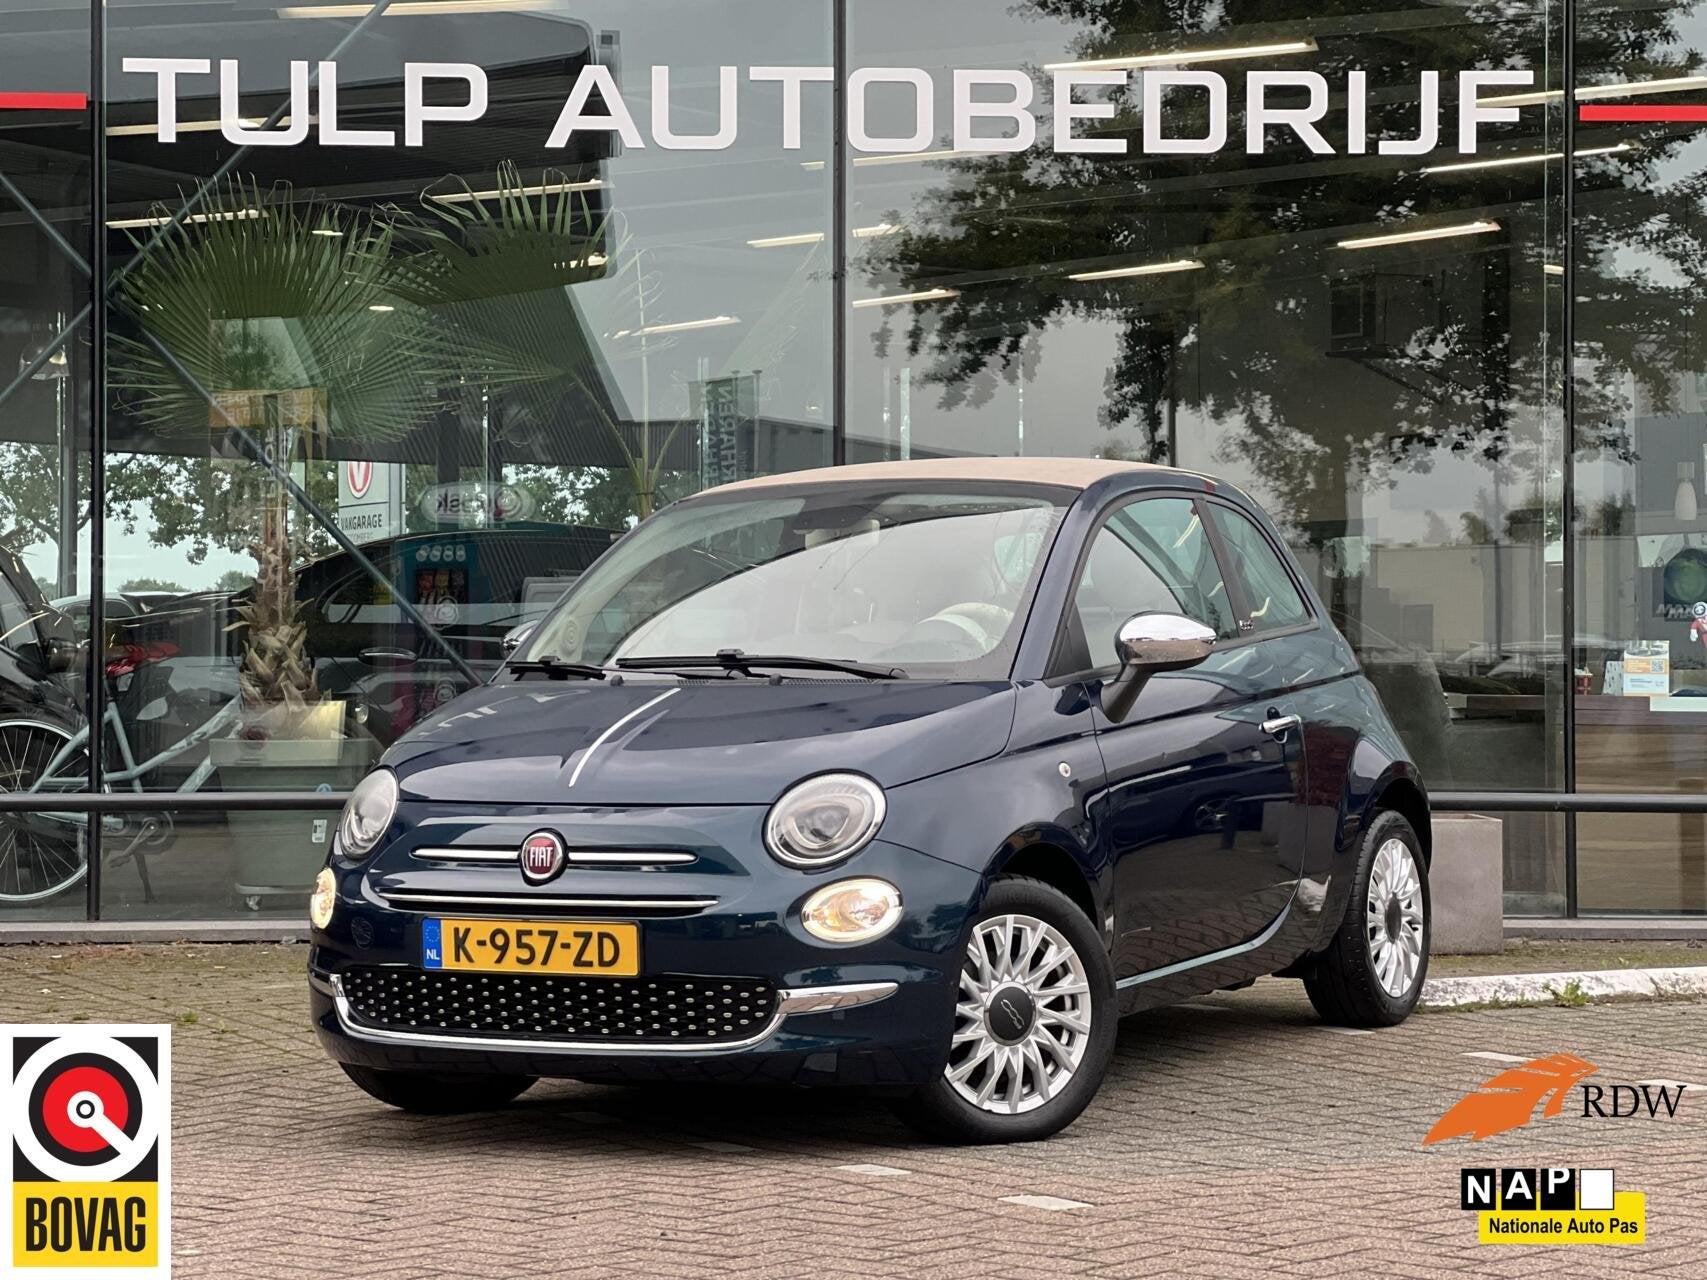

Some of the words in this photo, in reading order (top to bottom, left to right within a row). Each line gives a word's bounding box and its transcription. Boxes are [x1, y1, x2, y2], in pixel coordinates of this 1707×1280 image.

[123, 57, 489, 148] TULP
[544, 64, 1534, 156] AUTOBEDRIJF
[340, 513, 383, 531] VAKGARAGE
[529, 846, 554, 867] FIAT
[426, 948, 440, 961] NL
[453, 927, 621, 968] K-957-ZD
